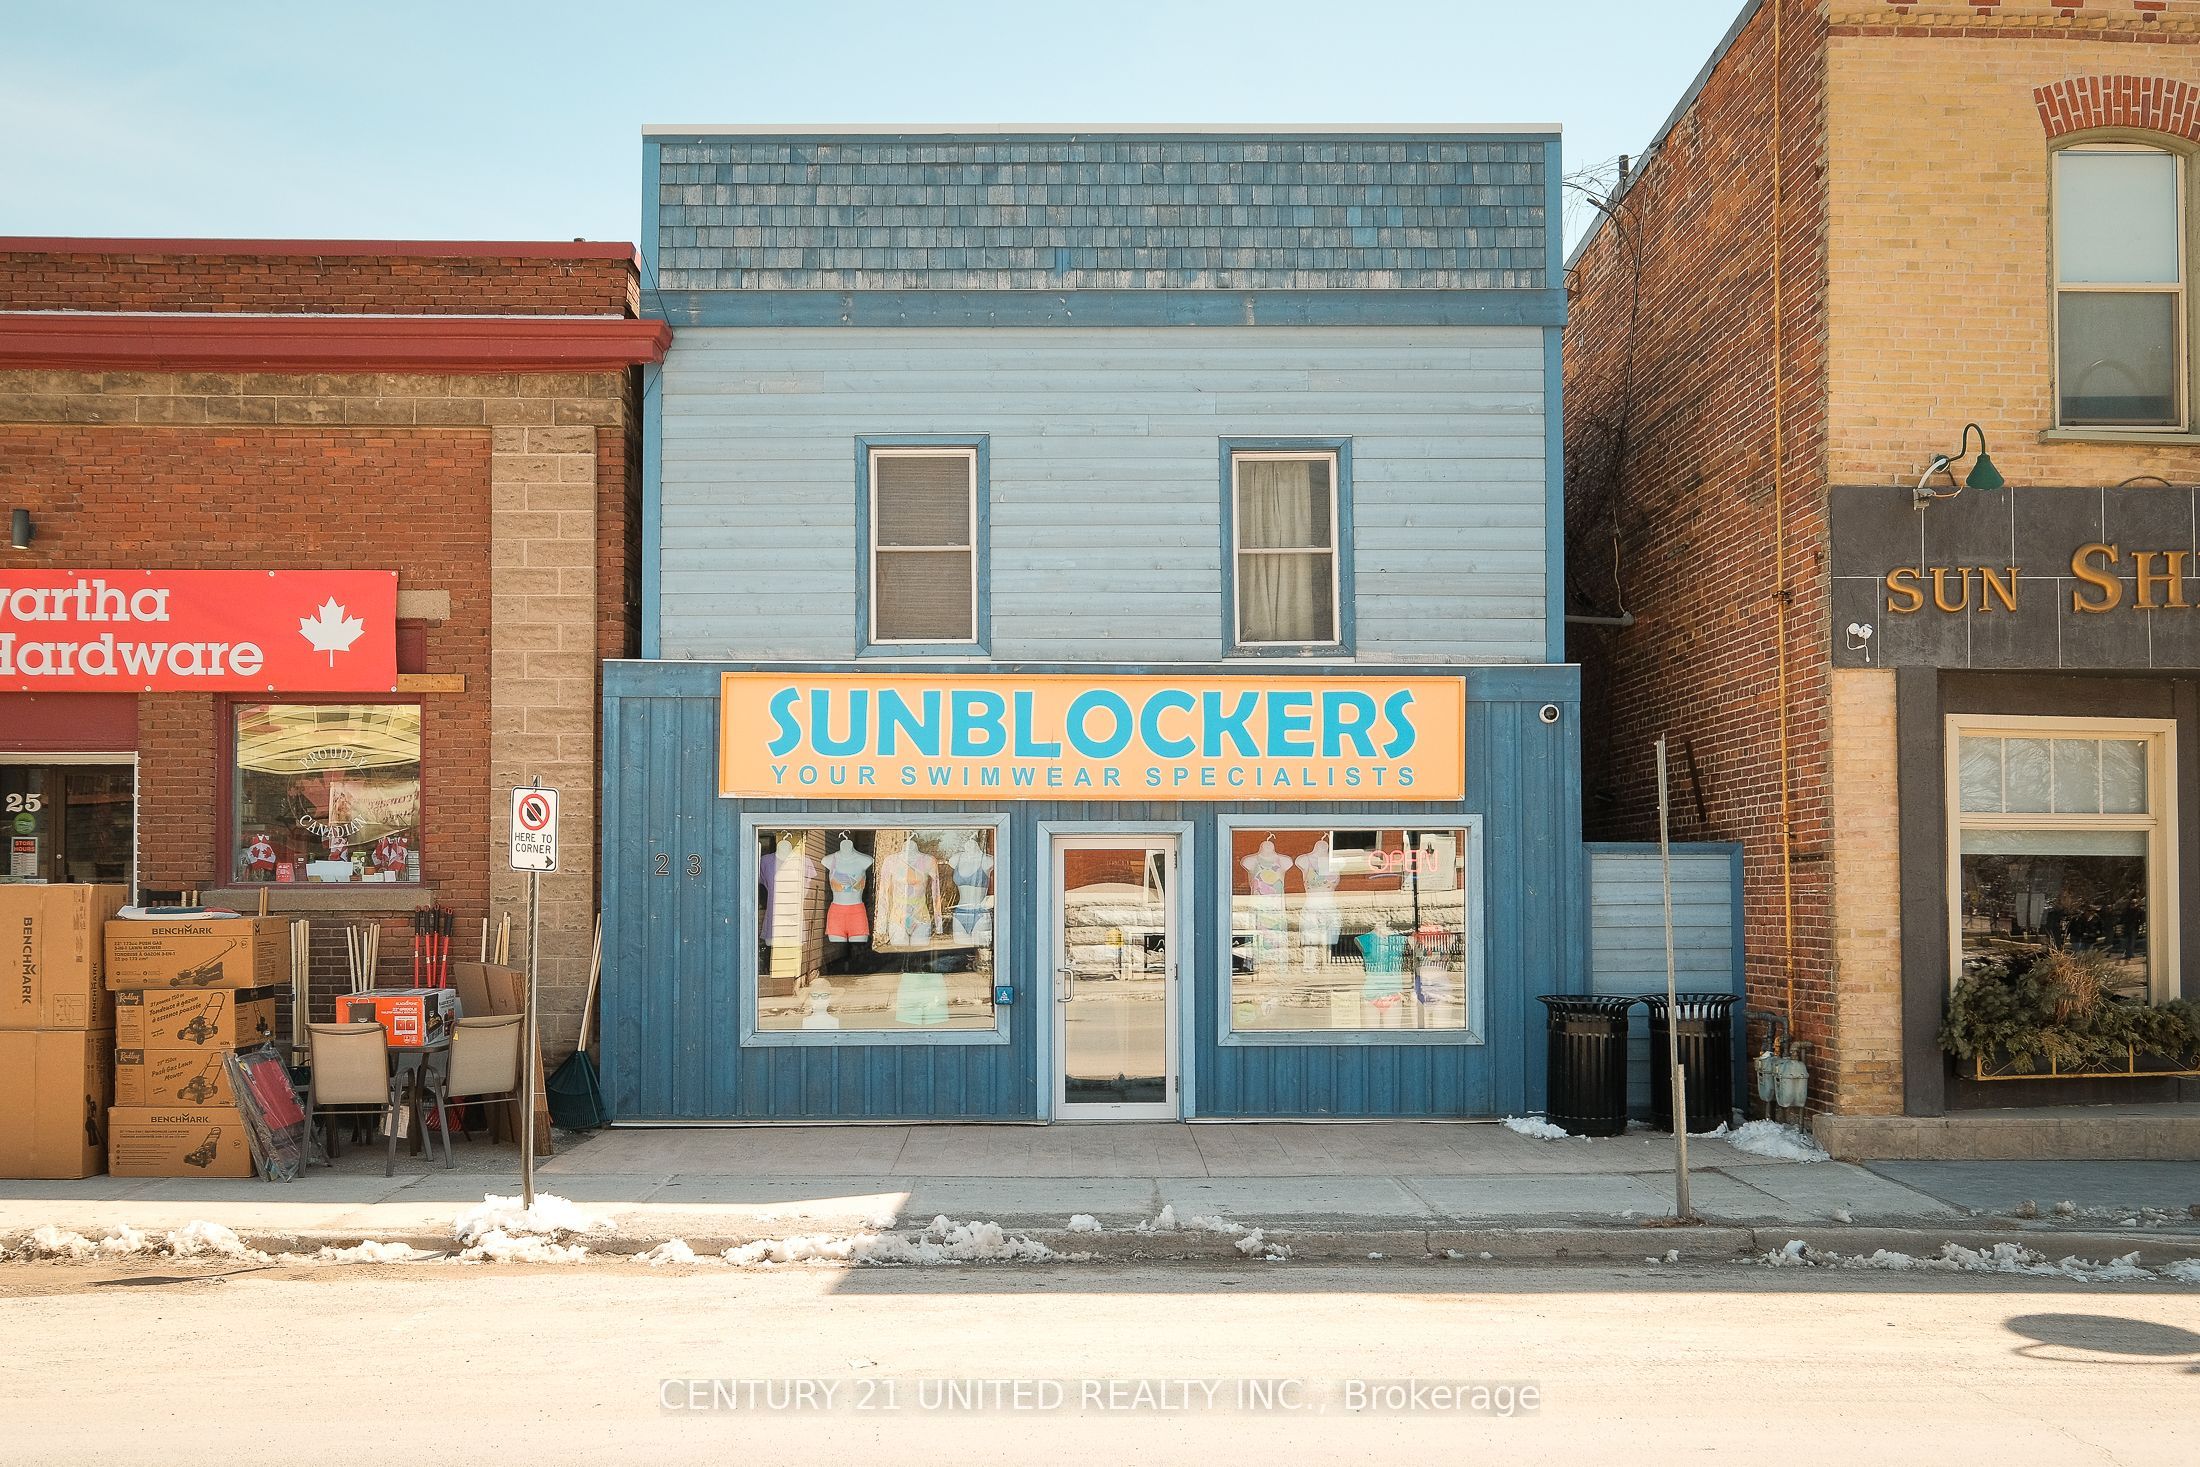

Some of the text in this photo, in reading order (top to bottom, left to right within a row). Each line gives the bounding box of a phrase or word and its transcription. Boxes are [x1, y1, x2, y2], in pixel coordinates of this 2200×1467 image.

[1886, 542, 2200, 613] SUN SH
[0, 579, 170, 622] artha
[768, 687, 1416, 759] SUNBLOCKERS
[299, 747, 368, 770] PROUDLY
[771, 765, 1415, 787] YOUR SWIMWEAR SPECIALISTS
[5, 793, 42, 812] 25
[299, 814, 368, 838] CANADIAN
[514, 832, 553, 844] HERE TO
[515, 842, 552, 854] CORNER
[1368, 849, 1439, 873] OPEN
[151, 924, 213, 935] BENCHMARK
[22, 916, 36, 1005] BENCHMARK
[151, 1060, 193, 1077] Push Gas Lawn
[164, 1071, 184, 1082] Mower
[150, 1113, 209, 1123] BENCHMARK
